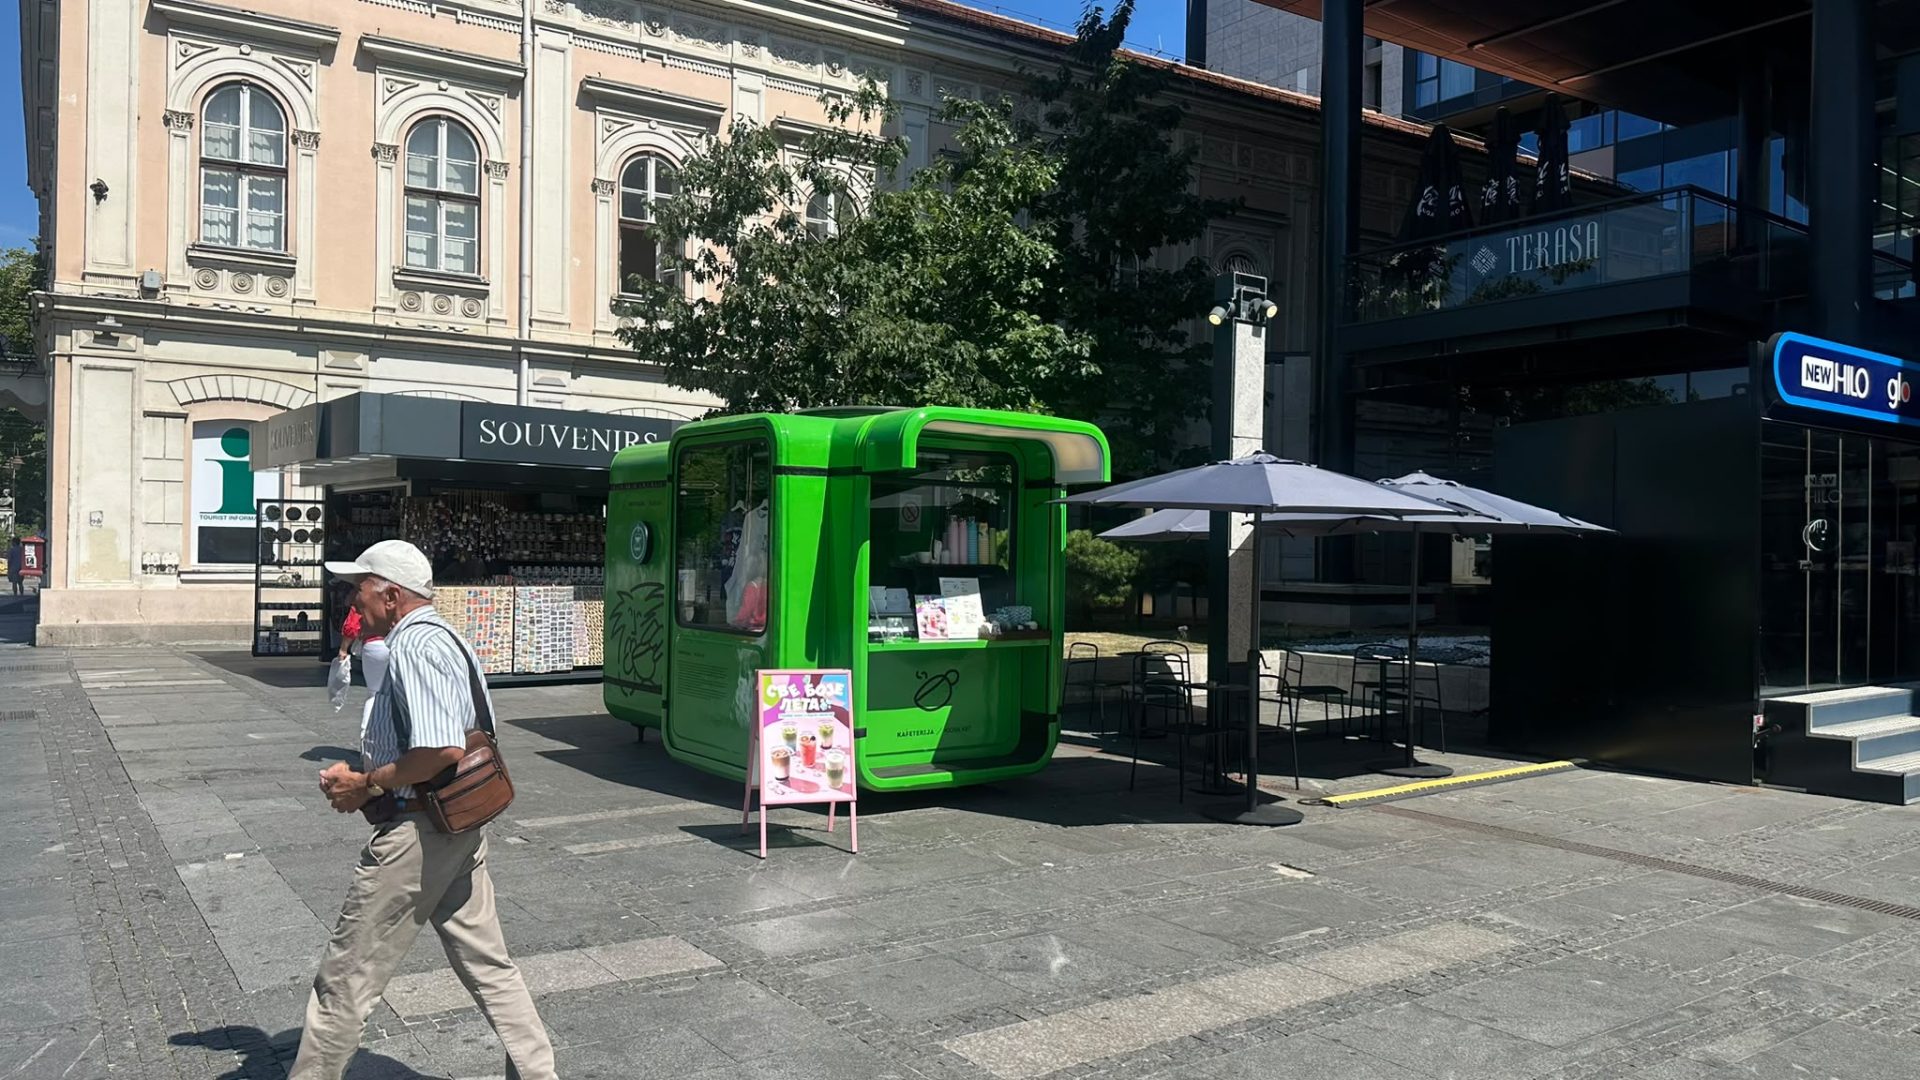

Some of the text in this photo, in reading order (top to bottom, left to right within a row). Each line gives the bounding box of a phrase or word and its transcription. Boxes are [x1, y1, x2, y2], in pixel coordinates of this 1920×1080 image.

[1506, 221, 1600, 274] TERASA
[1805, 362, 1911, 409] NEW HILO glo
[779, 697, 820, 713] ЛЕТА
